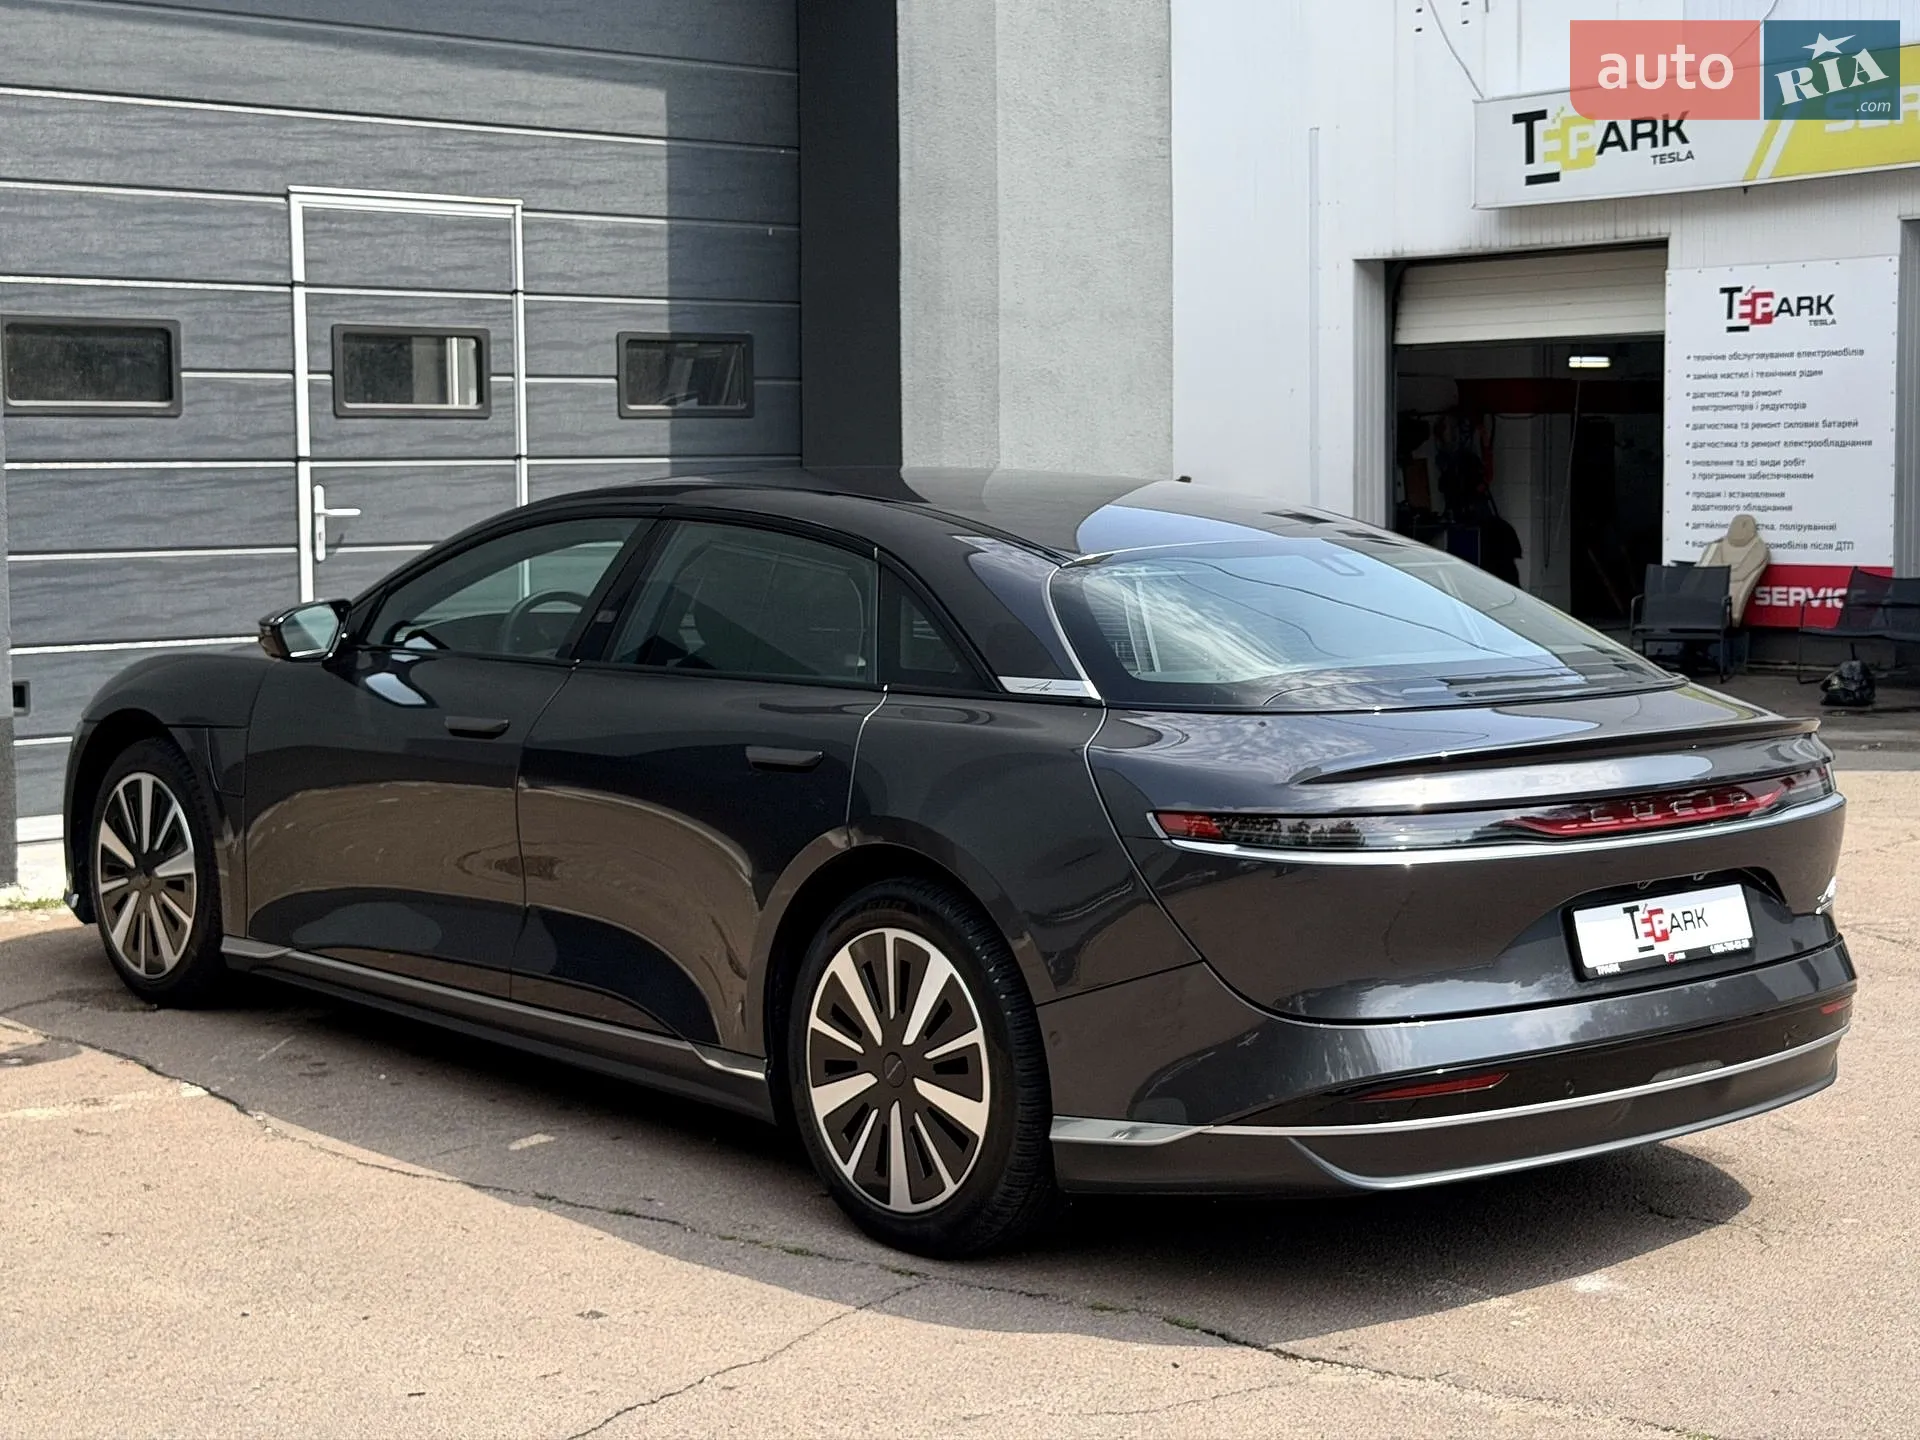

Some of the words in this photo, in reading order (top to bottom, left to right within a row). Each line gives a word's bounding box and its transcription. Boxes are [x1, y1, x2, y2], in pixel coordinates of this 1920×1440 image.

[1651, 149, 1695, 165] TESLA
[1808, 318, 1837, 327] TESLA
[1796, 347, 1865, 358] електромобілів
[1692, 372, 1718, 380] заміна
[1691, 390, 1739, 400] діагностика
[1751, 389, 1783, 399] ремонт
[1760, 401, 1807, 412] редукторів
[1691, 422, 1739, 431] діагностика
[1751, 422, 1781, 430] ремонт
[1783, 420, 1820, 429] силових
[1821, 418, 1859, 429] батарей
[1691, 440, 1739, 449] діагностика
[1751, 440, 1781, 449] ремонт
[1760, 459, 1781, 468] види
[1783, 458, 1806, 468] робіт
[1691, 491, 1722, 499] продаж
[1691, 504, 1741, 512] додаткового
[1742, 503, 1793, 511] обладнання
[1810, 541, 1834, 550] після
[1835, 541, 1854, 552] ДТП
